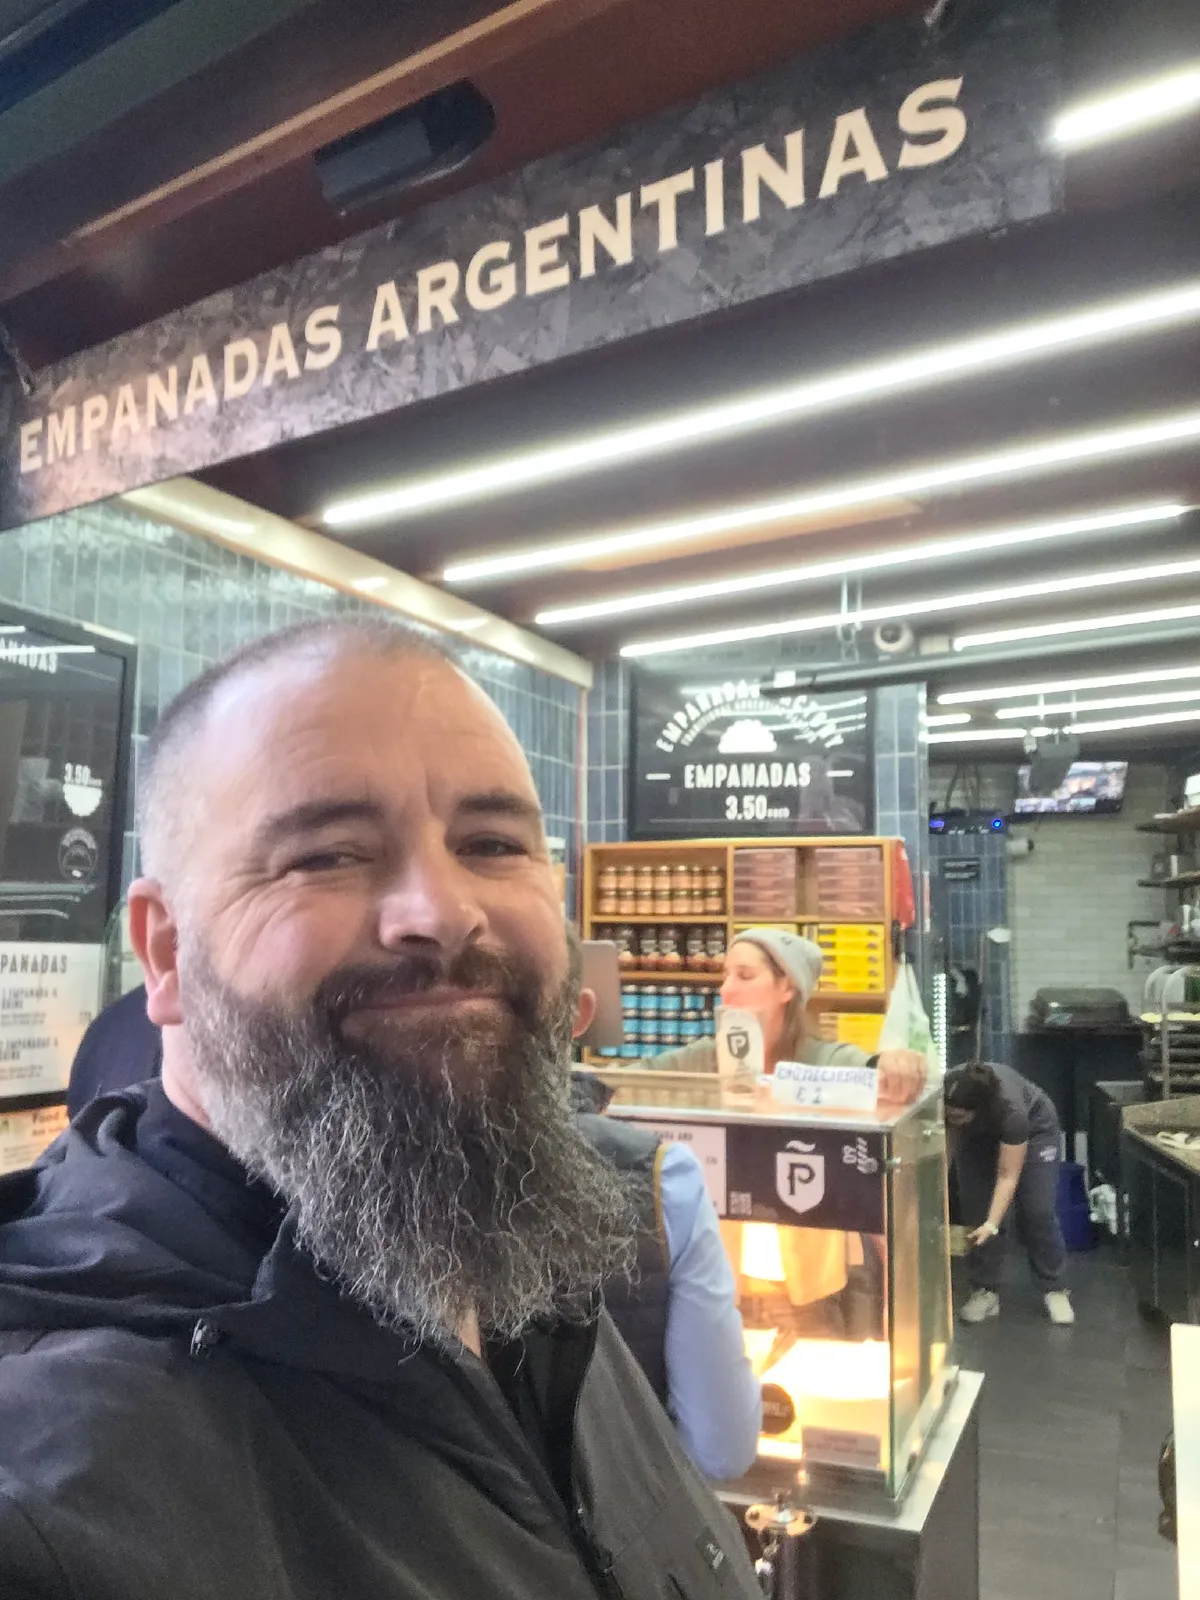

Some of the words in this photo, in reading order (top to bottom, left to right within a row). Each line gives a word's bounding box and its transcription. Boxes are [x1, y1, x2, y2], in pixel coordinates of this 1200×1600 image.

[19, 304, 342, 474] EMPANADAS
[365, 76, 968, 352] ARGENTINAS
[684, 762, 811, 788] EMPANADAS
